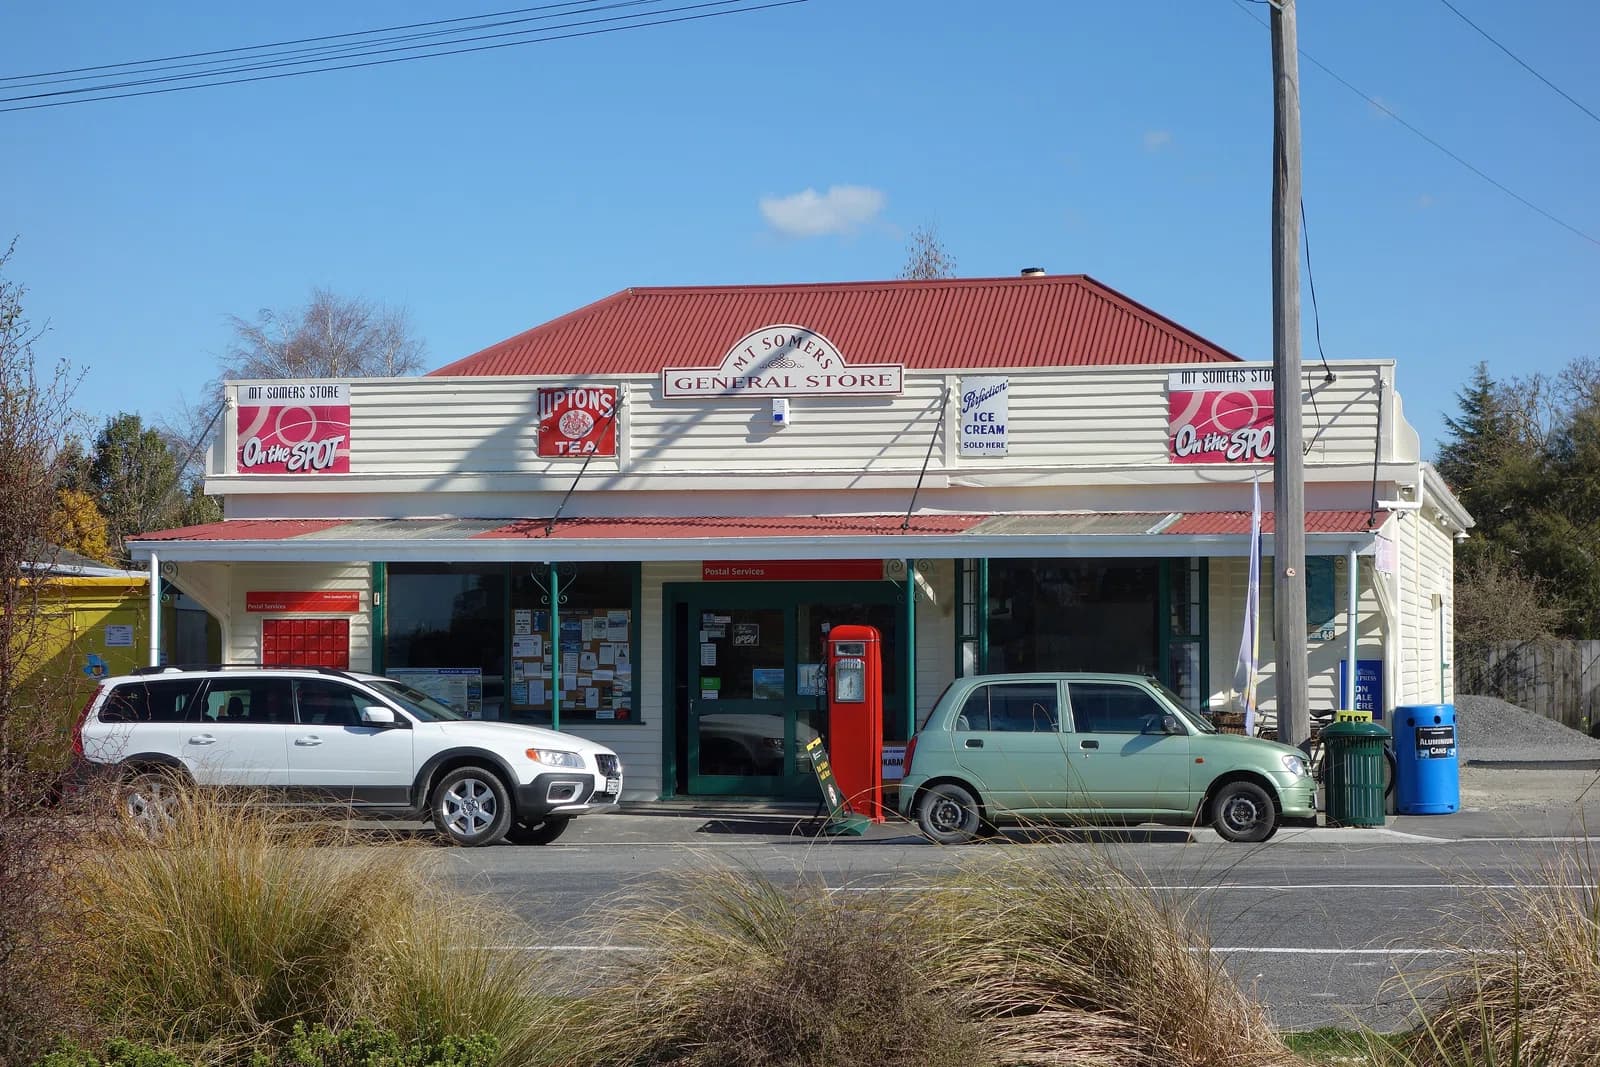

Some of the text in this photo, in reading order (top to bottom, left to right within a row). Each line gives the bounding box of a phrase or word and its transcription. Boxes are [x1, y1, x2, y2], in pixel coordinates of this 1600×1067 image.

[733, 334, 833, 372] MT SOMERS
[674, 373, 892, 390] GENERAL STORE
[1181, 370, 1197, 384] MT
[1202, 369, 1246, 383] SOMERS
[248, 385, 339, 400] MT SOMERS STORE
[973, 412, 995, 422] ICE
[964, 424, 1005, 435] CREAM
[554, 440, 600, 454] TEA
[963, 441, 1006, 449] SOLD HERE
[1175, 424, 1275, 460] On the SPO
[243, 434, 346, 471] On the SPOT
[704, 567, 765, 576] Postal Services
[1355, 693, 1373, 701] ALE
[1356, 702, 1374, 710] ERE
